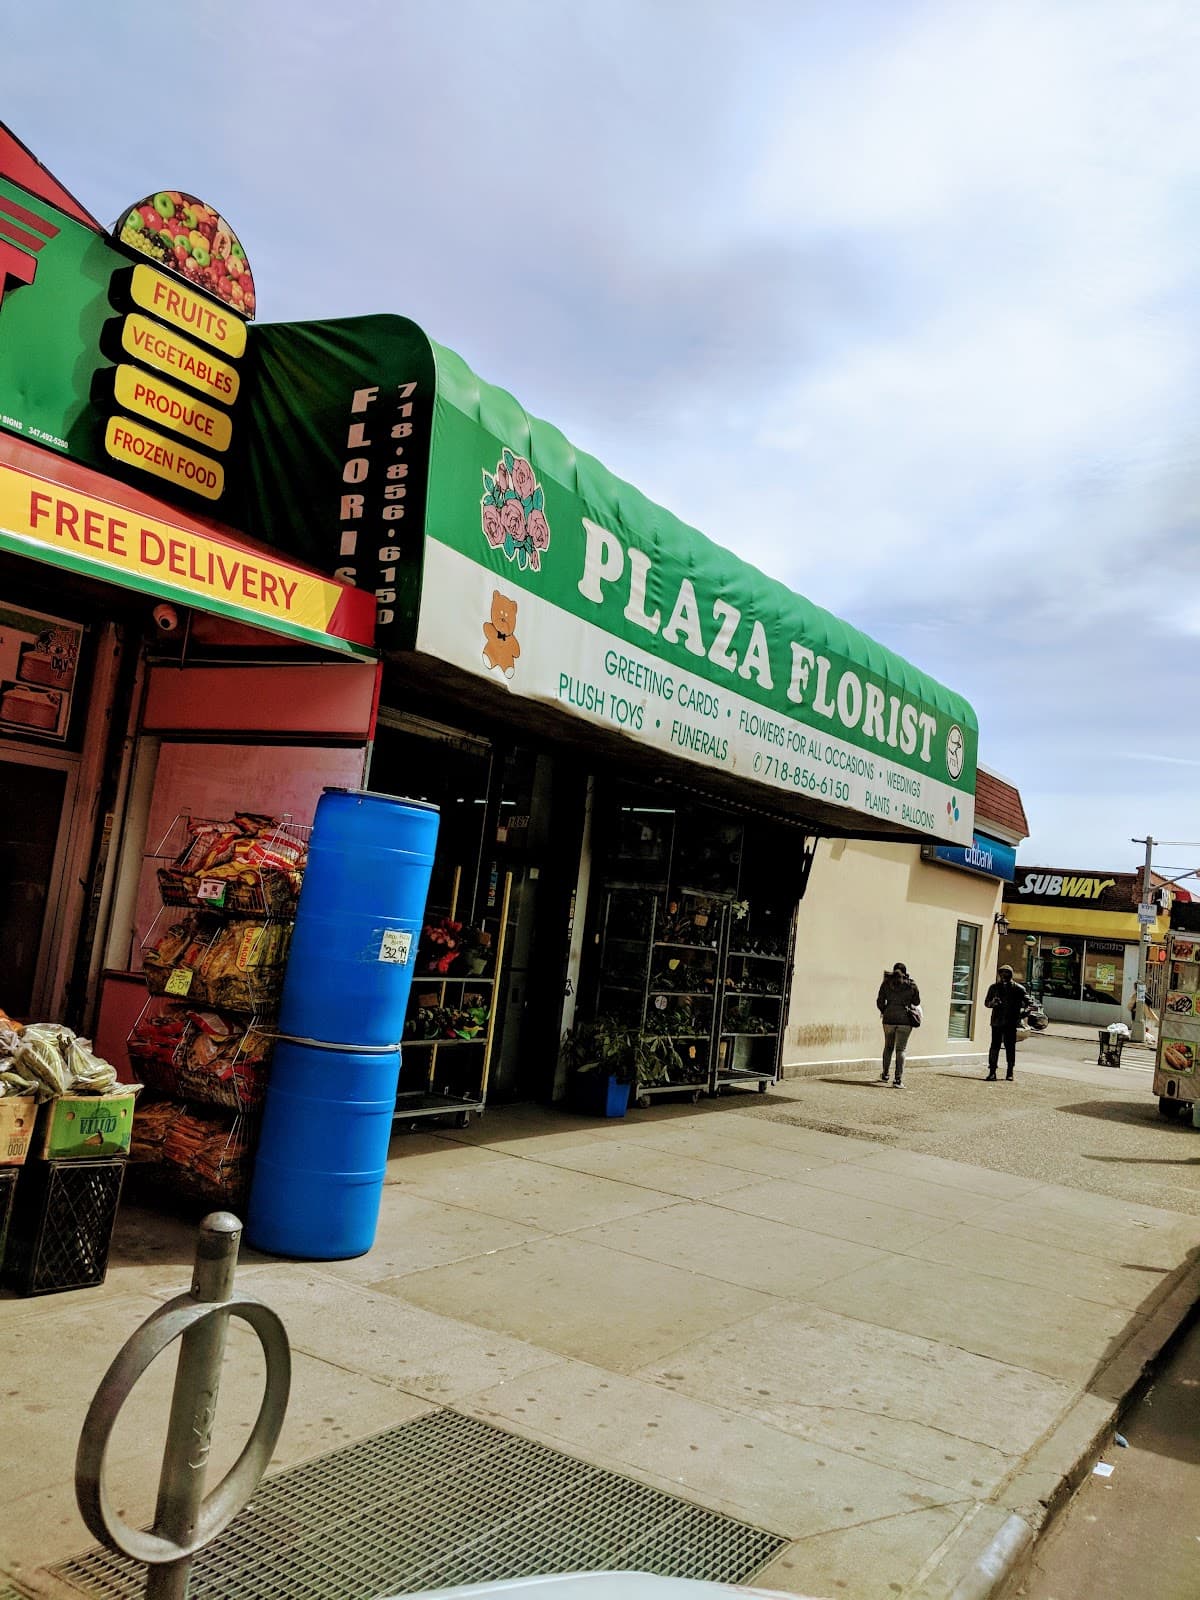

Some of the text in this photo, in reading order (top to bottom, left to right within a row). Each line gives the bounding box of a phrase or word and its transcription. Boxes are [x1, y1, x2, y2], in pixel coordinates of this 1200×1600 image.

[153, 281, 228, 341] FRUITS
[132, 325, 232, 394] VEGETABLES
[2, 415, 23, 430] SIGNS
[134, 383, 214, 437] PRODUCE
[113, 428, 217, 489] FROZEN FOOD
[29, 490, 298, 610] FREE DELIVERY
[577, 516, 937, 763] PLAZA FLORIST
[604, 650, 719, 719] GREETING CARDS
[559, 672, 729, 761] PLUSH TOYS FUNERALS
[739, 710, 921, 799] FLOWERS FOR ALL OCCASIONS WEEDINGS
[765, 755, 850, 801] 718-856-6150
[865, 791, 935, 830] PLANTS BALLOONS
[1018, 873, 1116, 899] SUBWAY
